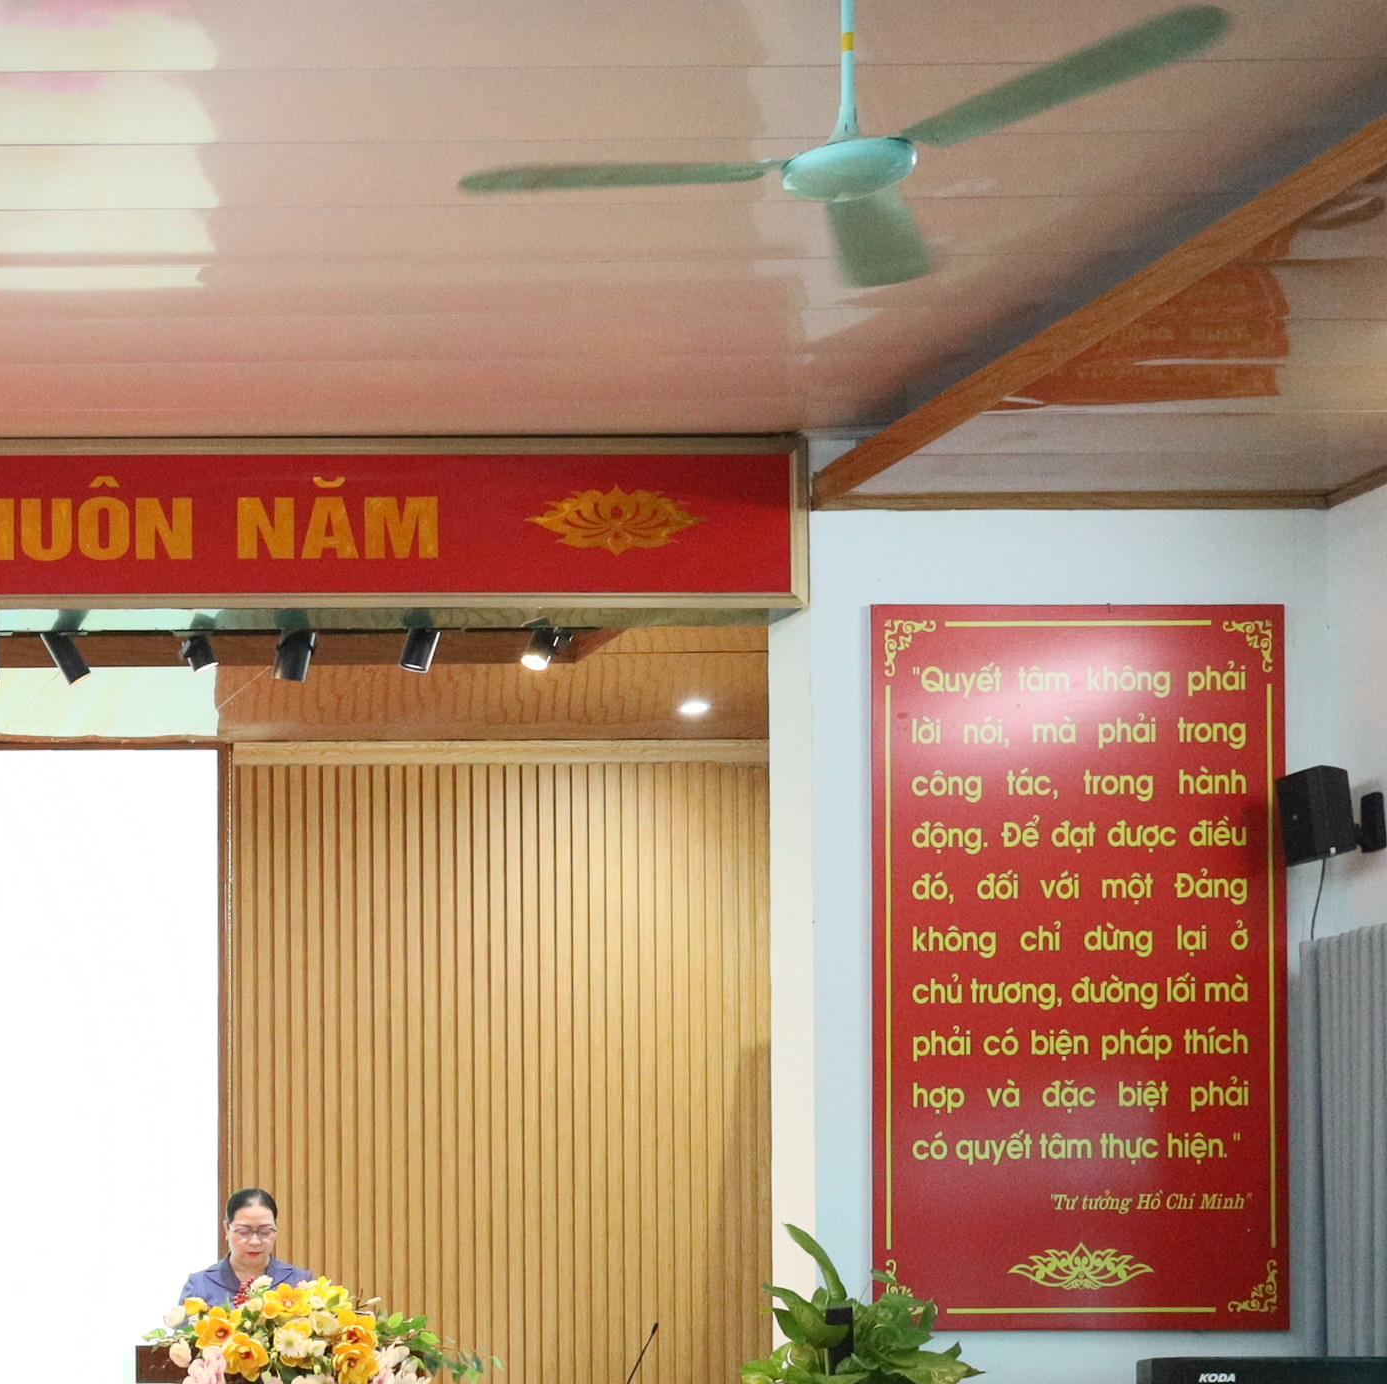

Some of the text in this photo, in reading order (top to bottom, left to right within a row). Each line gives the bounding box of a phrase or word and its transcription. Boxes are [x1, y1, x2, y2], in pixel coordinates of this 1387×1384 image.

[237, 477, 438, 559] NĂM
[913, 768, 1247, 802] công tác, trong hành
[912, 816, 1247, 854] động. Để đạt được điều
[913, 870, 1247, 904] đó, đối với một Đảng
[913, 920, 1248, 958] không chỉ dừng lại ở
[914, 973, 1248, 1009] chủ trương, đường lối mà
[914, 1027, 1248, 1061] phải có biện pháp thích
[913, 1077, 1249, 1113] hợp và đặc biệt phải
[913, 1131, 1241, 1165] có quyết tâm thực hiện."
[1051, 1190, 1252, 1214] "Tư tưởng Hồ Chí Minh"
[1198, 1373, 1236, 1383] KODA
